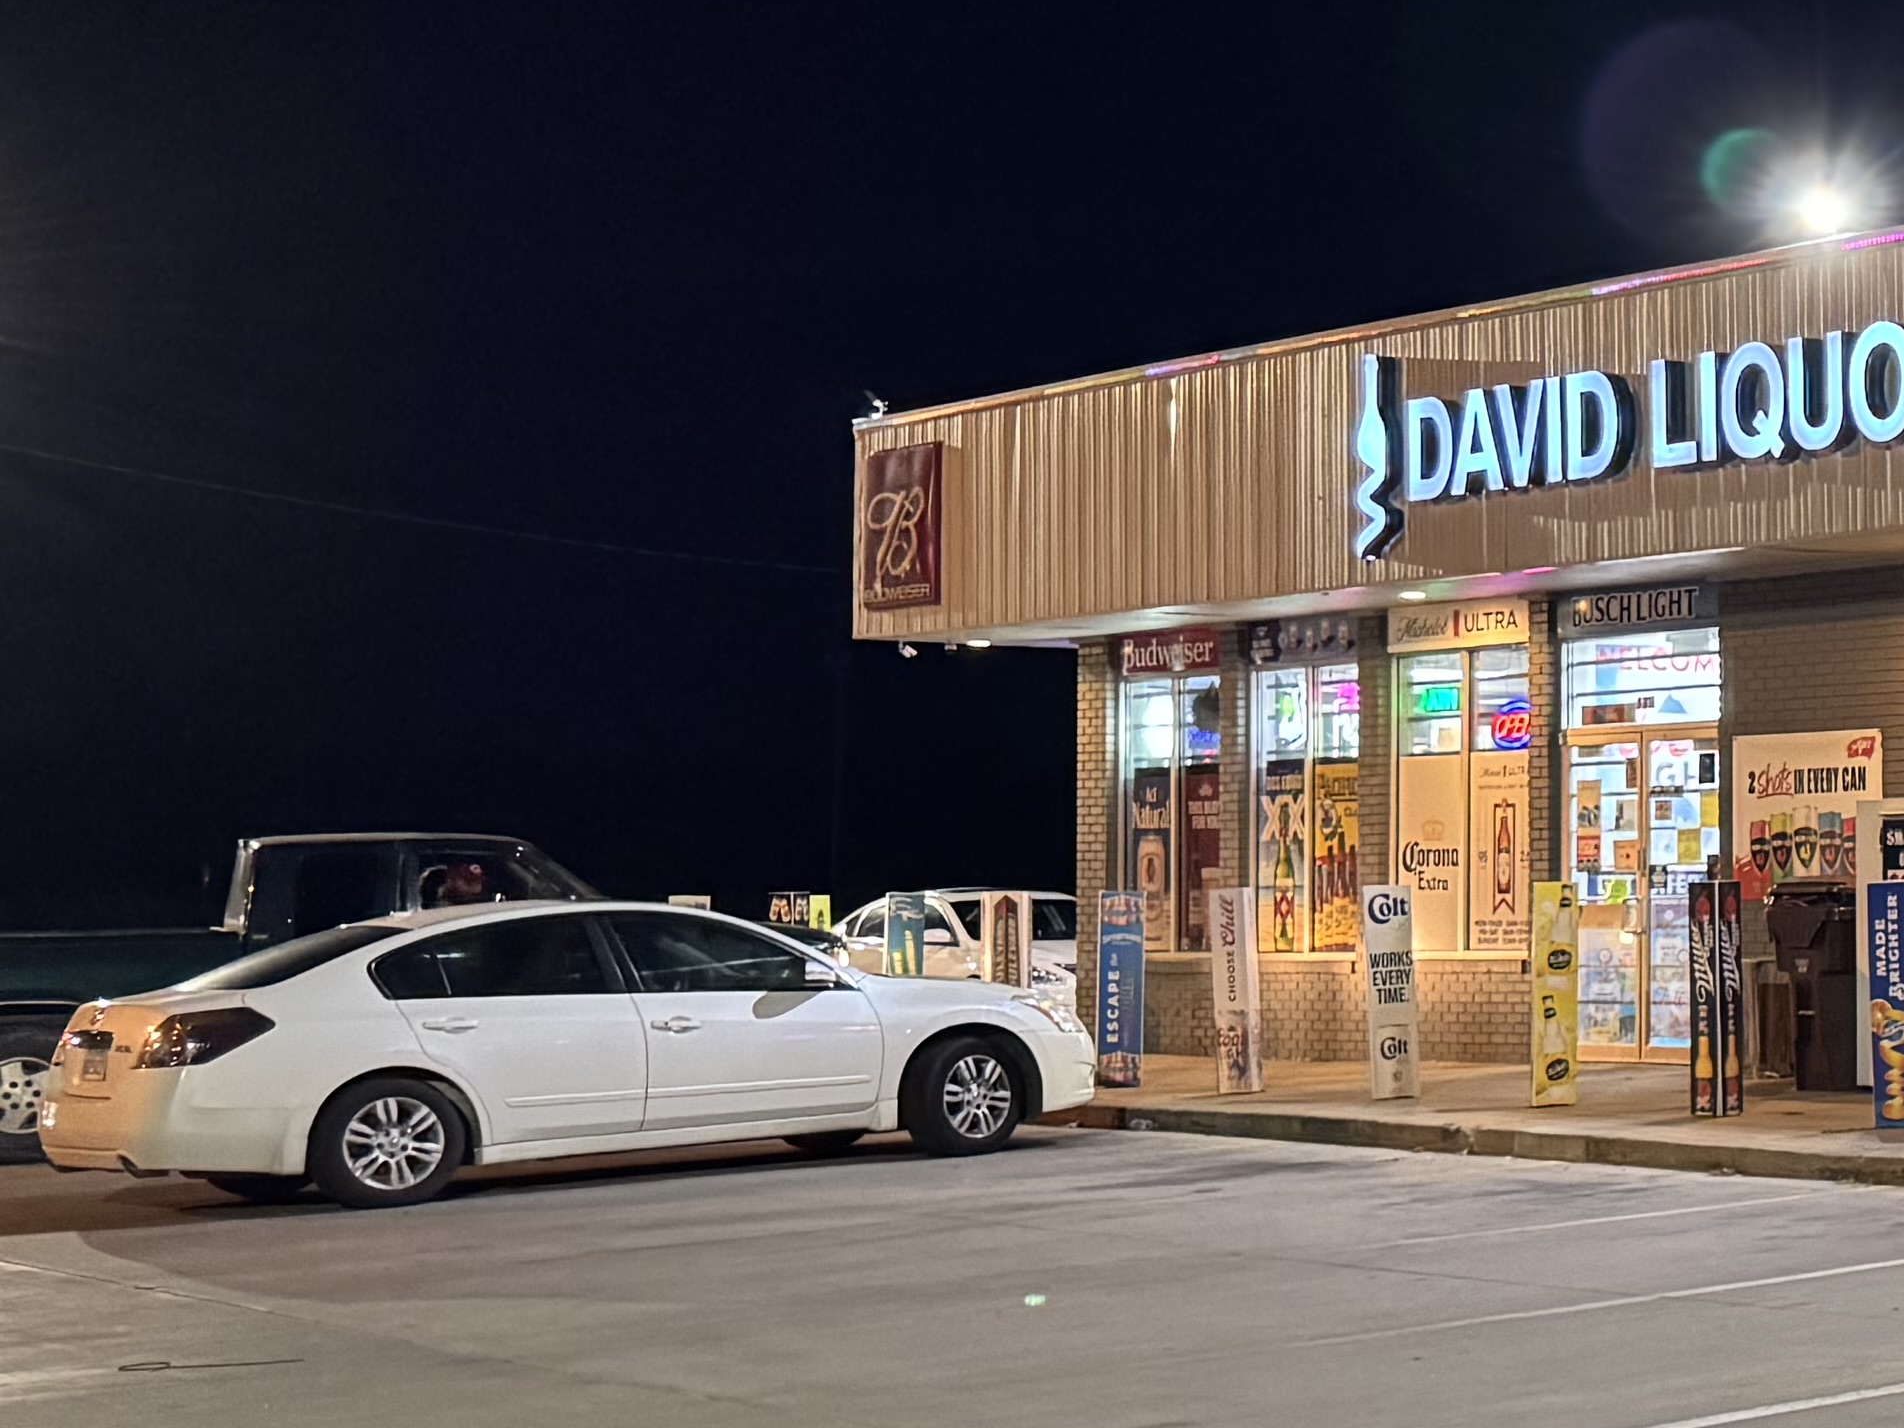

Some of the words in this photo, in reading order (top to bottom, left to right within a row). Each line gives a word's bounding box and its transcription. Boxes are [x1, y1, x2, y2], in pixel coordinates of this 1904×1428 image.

[1408, 369, 1620, 503] DAVID
[1464, 609, 1518, 632] ULTRA
[1572, 596, 1632, 627] BUSCH
[1637, 587, 1699, 620] LIGHT
[1122, 635, 1214, 675] Budweiser
[1597, 647, 1714, 673] WELCOM
[1496, 712, 1530, 740] OPE
[1748, 771, 1756, 795] 2
[1756, 761, 1794, 799] shots
[1794, 768, 1805, 795] IN
[1807, 766, 1840, 794] EVERY
[1842, 765, 1867, 792] CAN
[1261, 794, 1306, 841] XX
[1402, 840, 1460, 875] Corona
[1415, 870, 1450, 891] Extra
[1221, 894, 1236, 948] Chill
[1367, 893, 1409, 925] Colt
[1369, 950, 1414, 969] WORKS
[1874, 918, 1888, 977] MADE
[1227, 949, 1236, 1002] CHOOSE
[1372, 969, 1412, 987] EVERY
[1106, 970, 1121, 1044] ESCAPE
[1376, 986, 1410, 1005] TIME.
[1380, 1036, 1408, 1061] Colt
